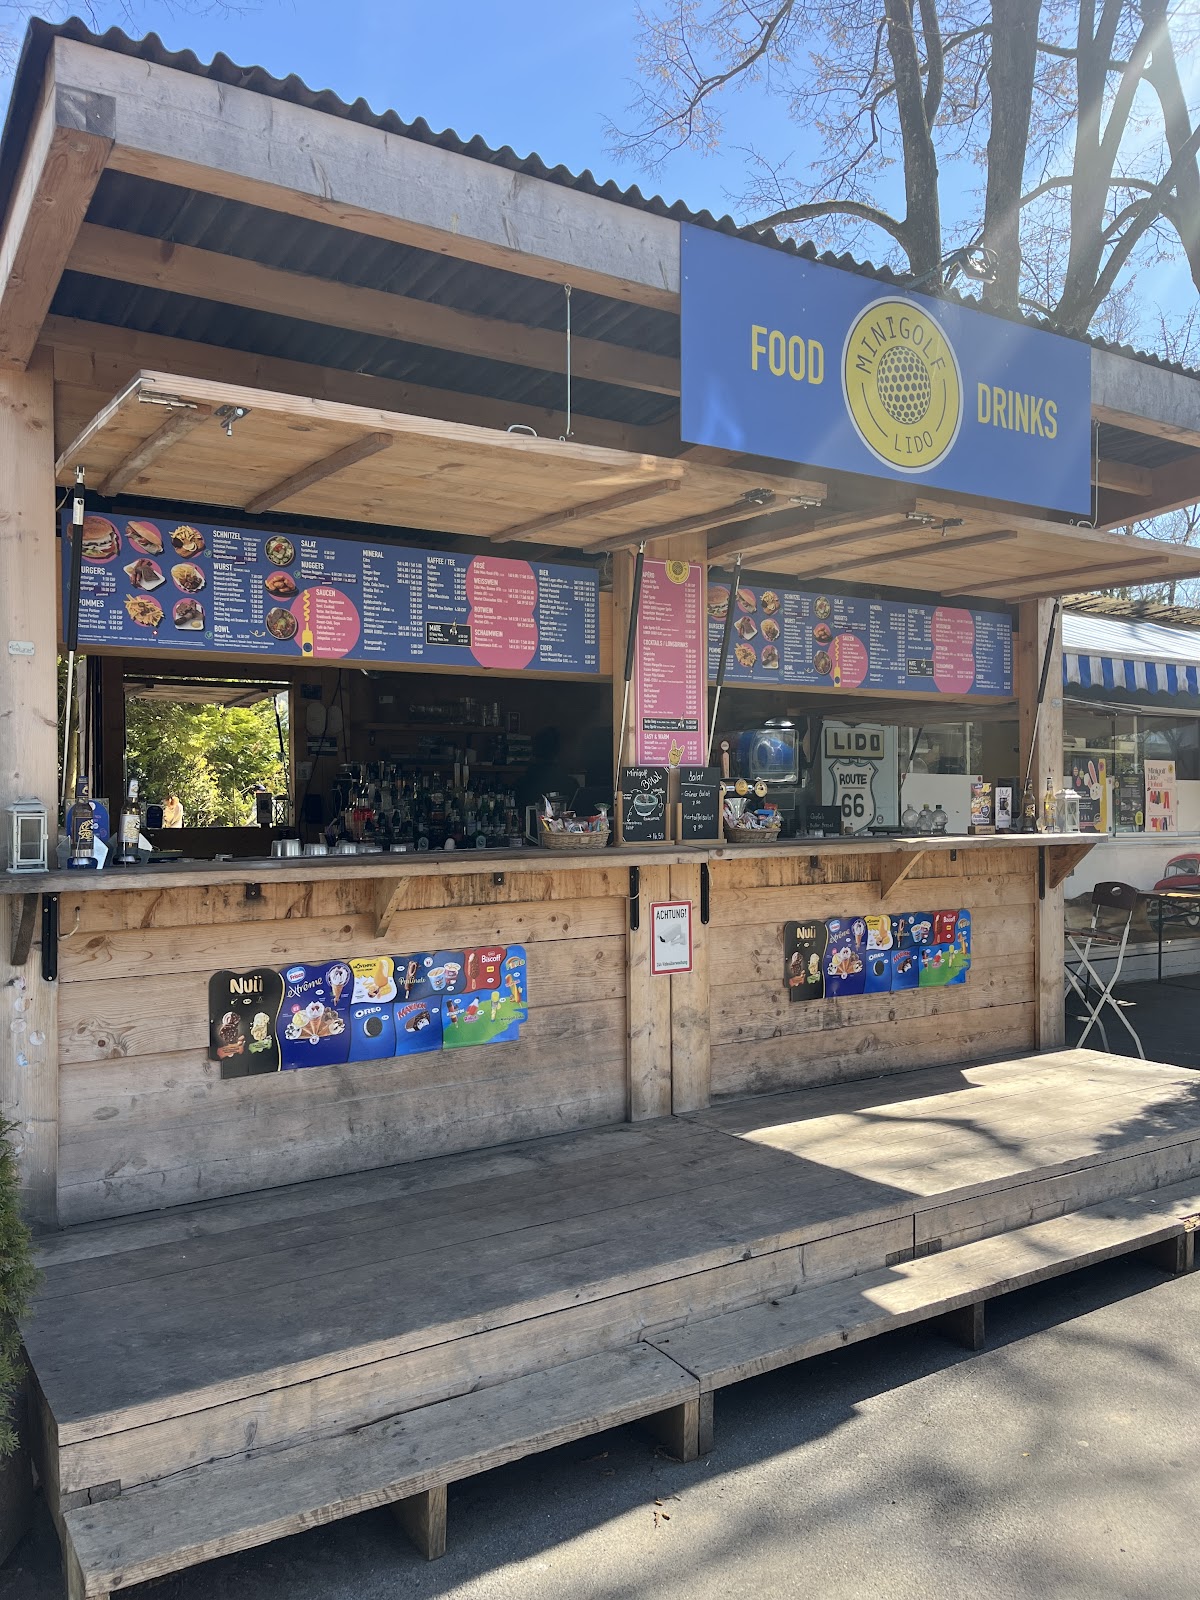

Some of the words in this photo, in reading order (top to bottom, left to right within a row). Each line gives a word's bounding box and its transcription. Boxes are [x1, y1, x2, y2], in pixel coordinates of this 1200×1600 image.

[855, 316, 947, 375] MINIGOLF
[750, 324, 825, 385] FOOD
[977, 382, 1058, 440] DRINKS
[894, 430, 933, 454] LIDO
[213, 530, 241, 540] SCHNITZEL
[363, 550, 384, 558] MINERAL
[80, 566, 106, 575] URGERS
[301, 561, 324, 570] NUGGETS
[474, 578, 498, 586] WEISSWEIN
[214, 625, 230, 633] BOWL
[834, 732, 880, 751] LIDO
[627, 769, 648, 779] Minigolf
[688, 771, 704, 782] Salat
[839, 773, 867, 785] ROUTE
[842, 793, 865, 818] 66
[656, 908, 687, 920] ACHTUNG!
[482, 954, 501, 963] Biscoff
[355, 1007, 381, 1018] OREO
